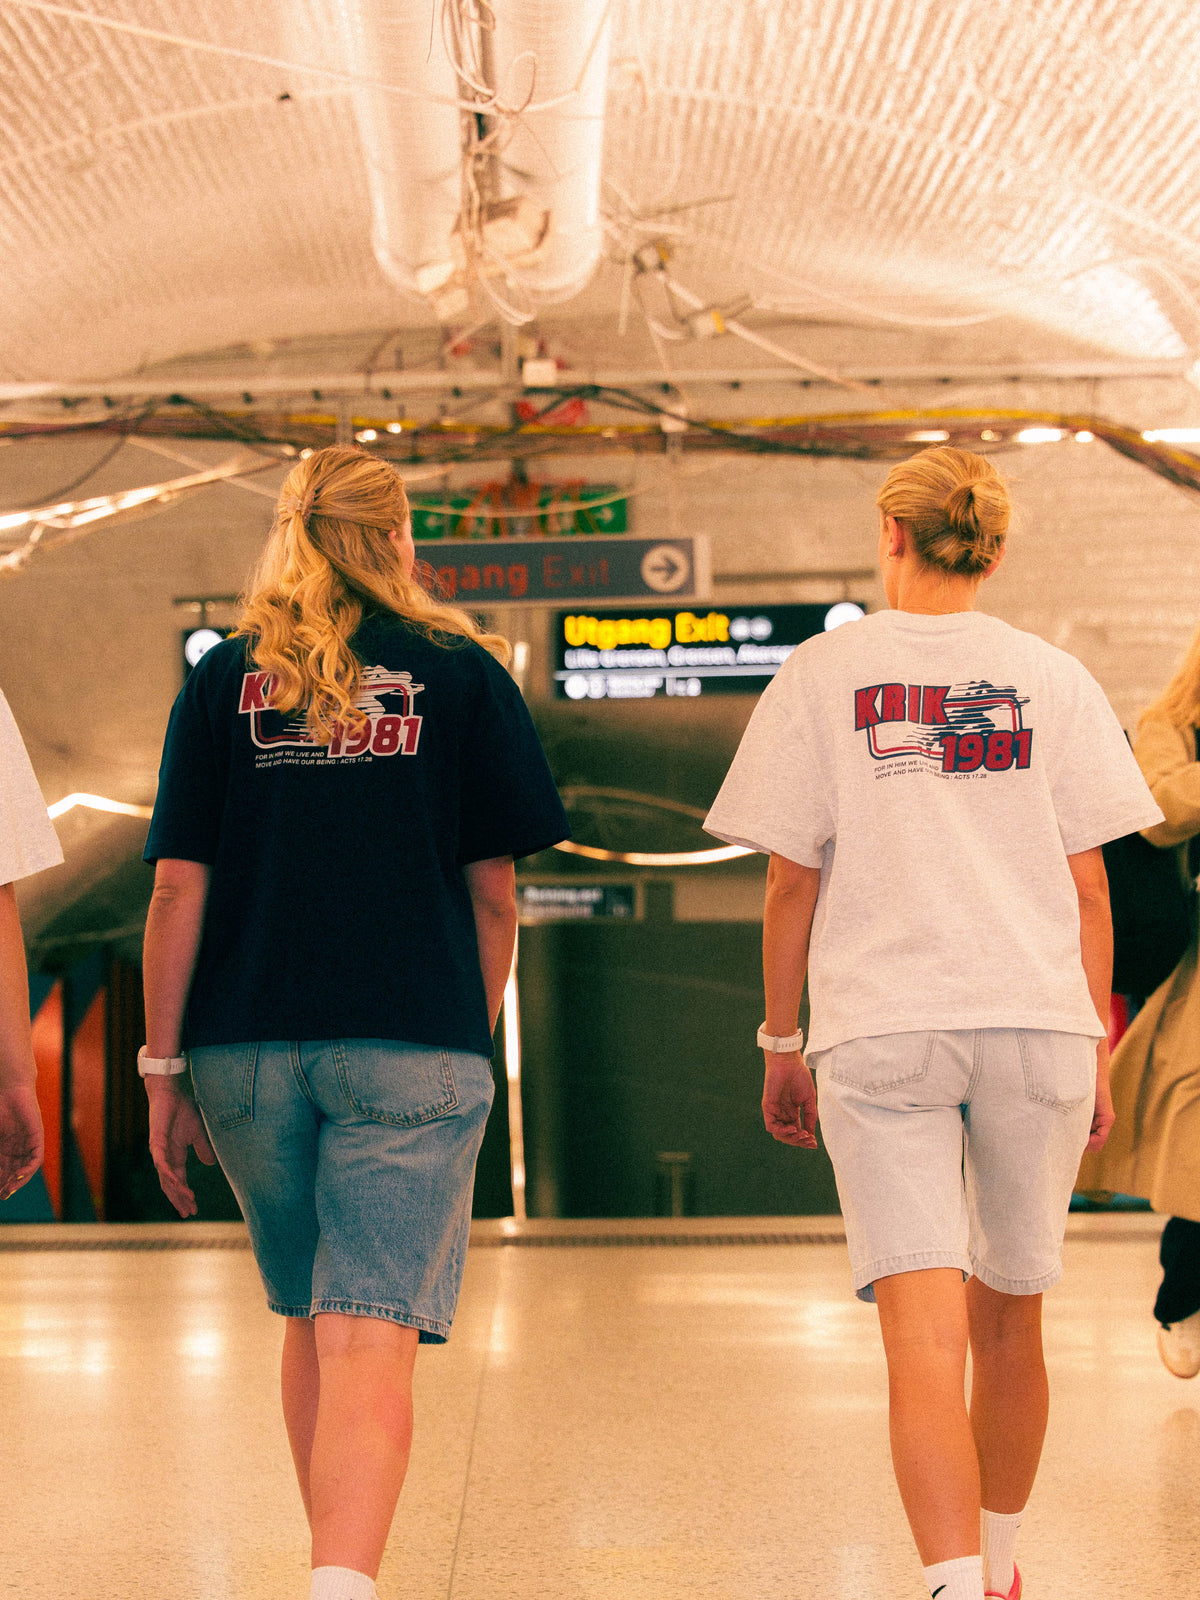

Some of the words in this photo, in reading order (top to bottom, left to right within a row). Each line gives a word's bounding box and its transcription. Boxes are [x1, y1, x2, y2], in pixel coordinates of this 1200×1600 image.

[410, 558, 528, 598] tgang
[542, 554, 609, 588] Exit
[564, 615, 672, 650] Utgang
[674, 612, 730, 642] Exit
[854, 682, 952, 732] KRIK
[327, 713, 424, 758] 1981
[940, 728, 1033, 773] 1981
[255, 761, 272, 769] MOVE
[874, 765, 886, 773] FOR
[875, 772, 891, 780] MOVE
